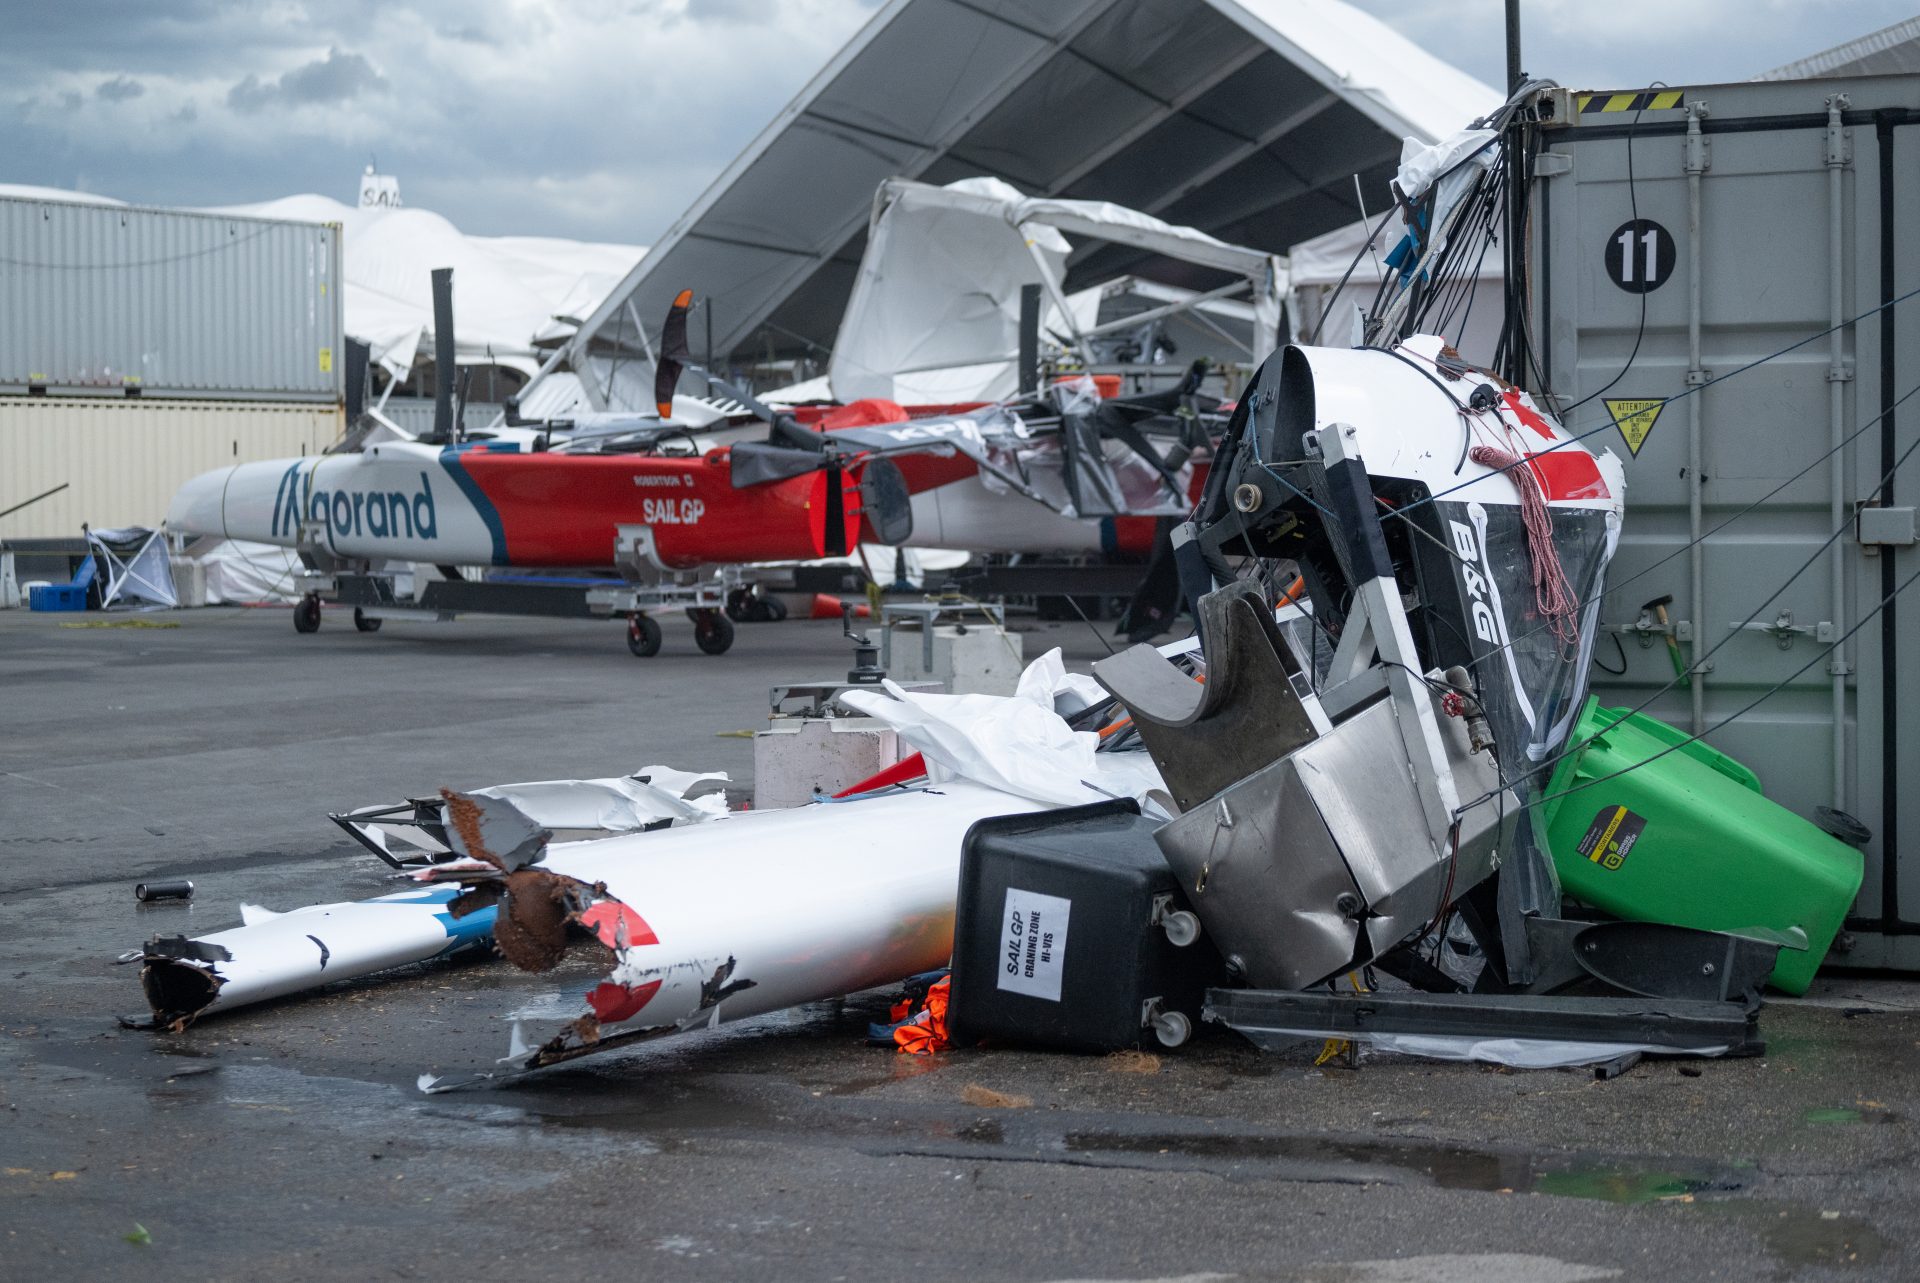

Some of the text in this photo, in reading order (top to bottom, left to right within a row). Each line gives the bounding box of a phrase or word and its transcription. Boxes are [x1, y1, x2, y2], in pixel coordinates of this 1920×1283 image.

[1618, 230, 1657, 281] 11
[1617, 403, 1654, 411] ATTENTION
[272, 460, 438, 546] Algorand
[1449, 519, 1499, 646] B&G
[1598, 818, 1620, 851] CONTAINERS
[1616, 834, 1631, 855] GRASS
[1621, 833, 1637, 858] HOPPER
[1025, 911, 1040, 978] CRANING ZONE
[1041, 932, 1053, 963] HI-VIS
